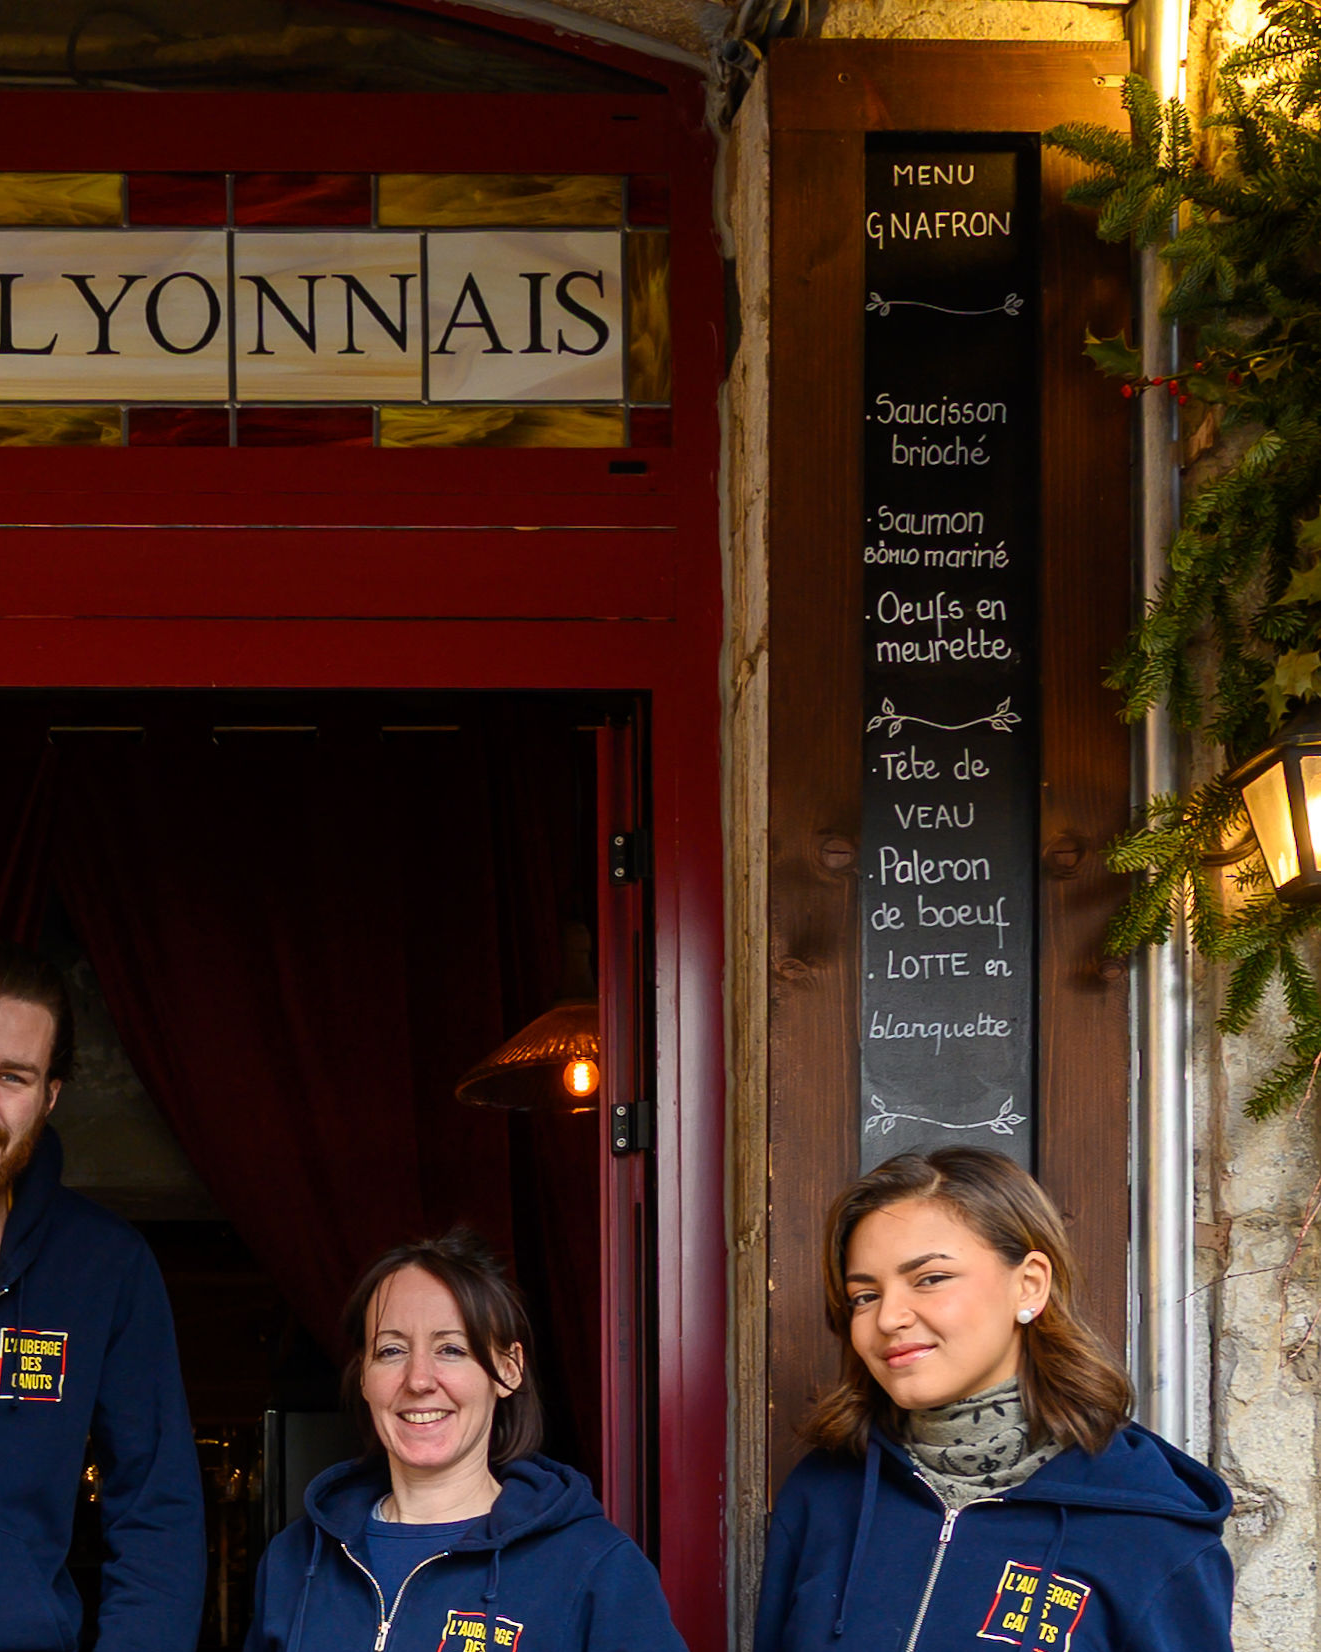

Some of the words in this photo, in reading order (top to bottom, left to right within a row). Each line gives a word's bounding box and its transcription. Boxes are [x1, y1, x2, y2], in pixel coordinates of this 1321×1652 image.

[892, 164, 976, 187] MENU
[866, 211, 1012, 249] GNAFRON
[876, 393, 1007, 424] Saucisson
[891, 435, 991, 466] brioché
[878, 505, 984, 535] Saumon
[924, 541, 1009, 569] mariné
[877, 591, 964, 637] Oeufs
[976, 598, 1007, 621] en
[877, 628, 1012, 663] meurette
[880, 745, 941, 781] Tête
[953, 748, 991, 781] de
[894, 802, 975, 829] VEAU
[878, 846, 991, 885] Paleron
[870, 901, 905, 931] de
[917, 895, 1011, 949] boeuf
[887, 950, 970, 980] LOTTE
[984, 959, 1014, 978] en
[869, 1010, 1012, 1056] blanquette
[21, 1355, 42, 1372] DES
[1004, 1572, 1082, 1611] L'AUERGE
[1001, 1612, 1059, 1644] CATS
